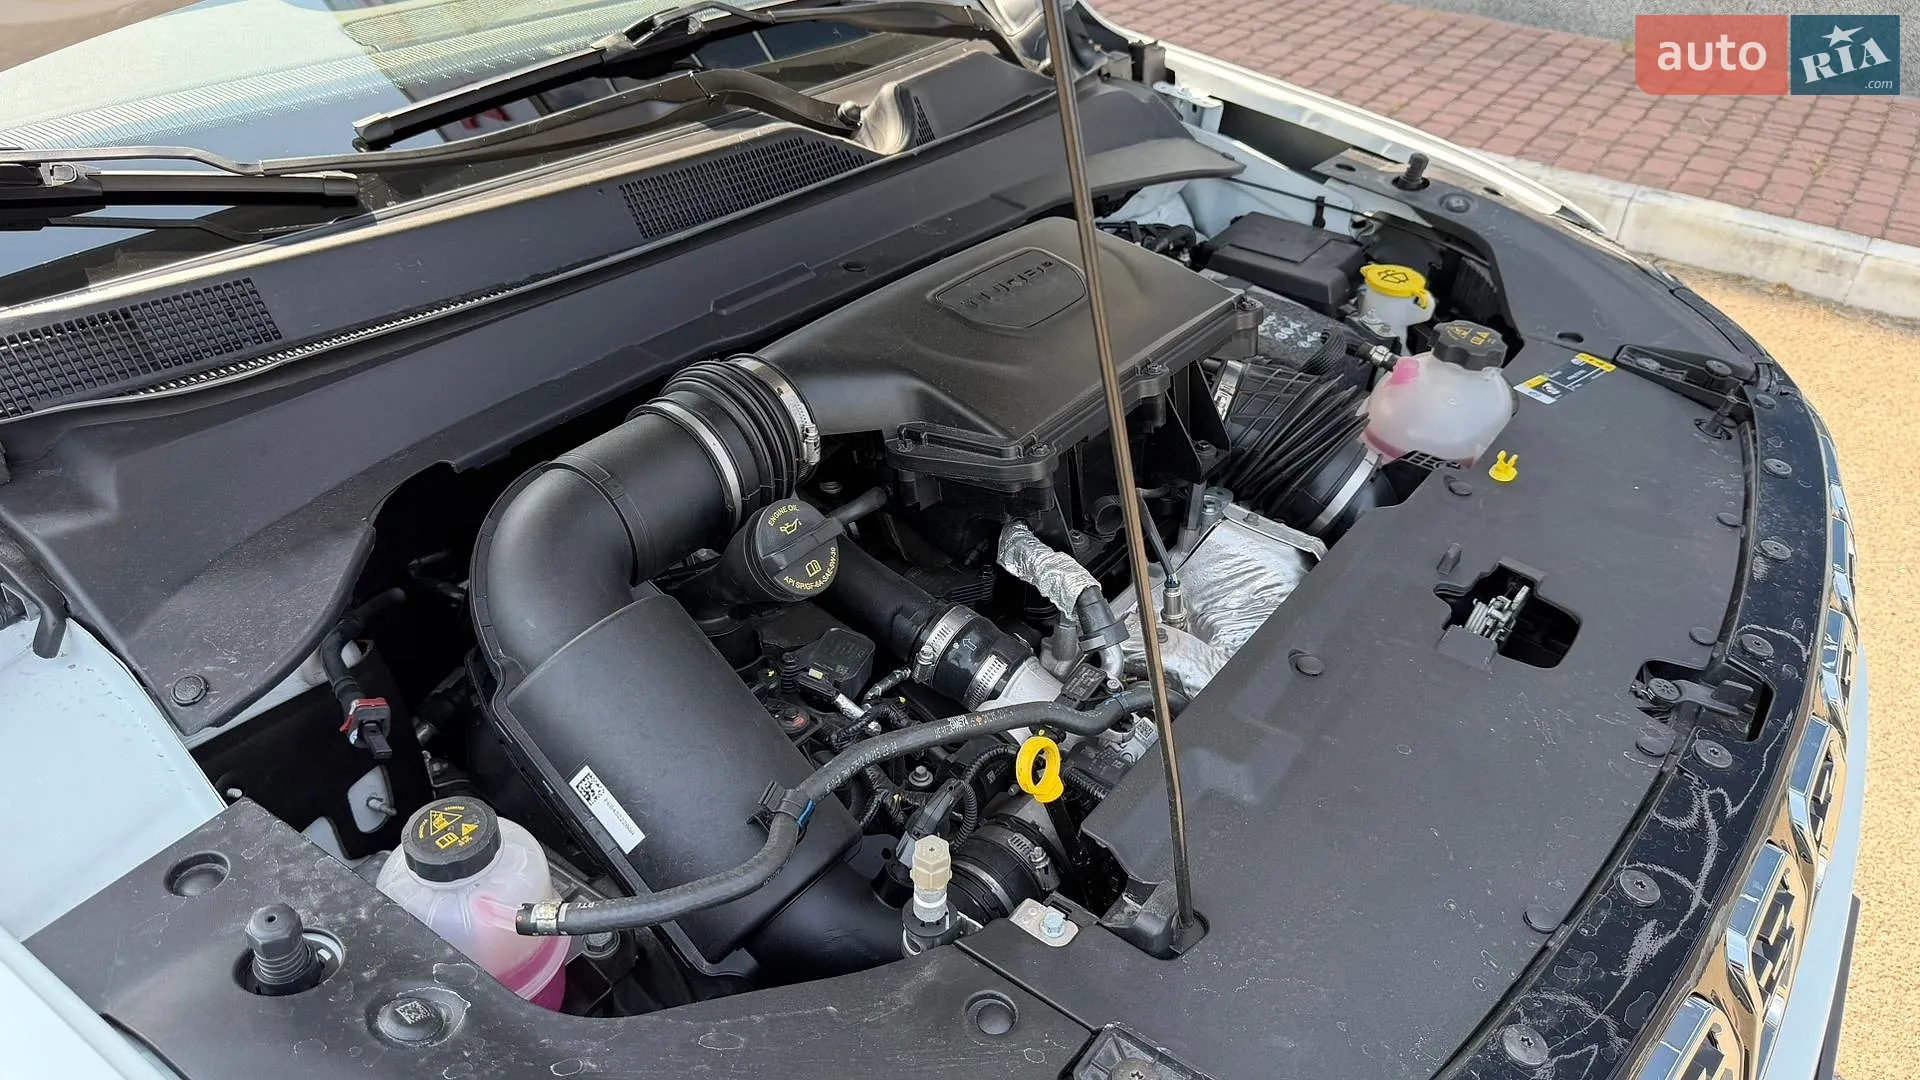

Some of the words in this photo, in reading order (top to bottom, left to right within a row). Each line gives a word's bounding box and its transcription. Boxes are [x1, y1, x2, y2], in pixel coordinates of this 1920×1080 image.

[767, 505, 790, 527] ENGINE
[788, 503, 800, 512] OIL
[783, 575, 796, 587] API
